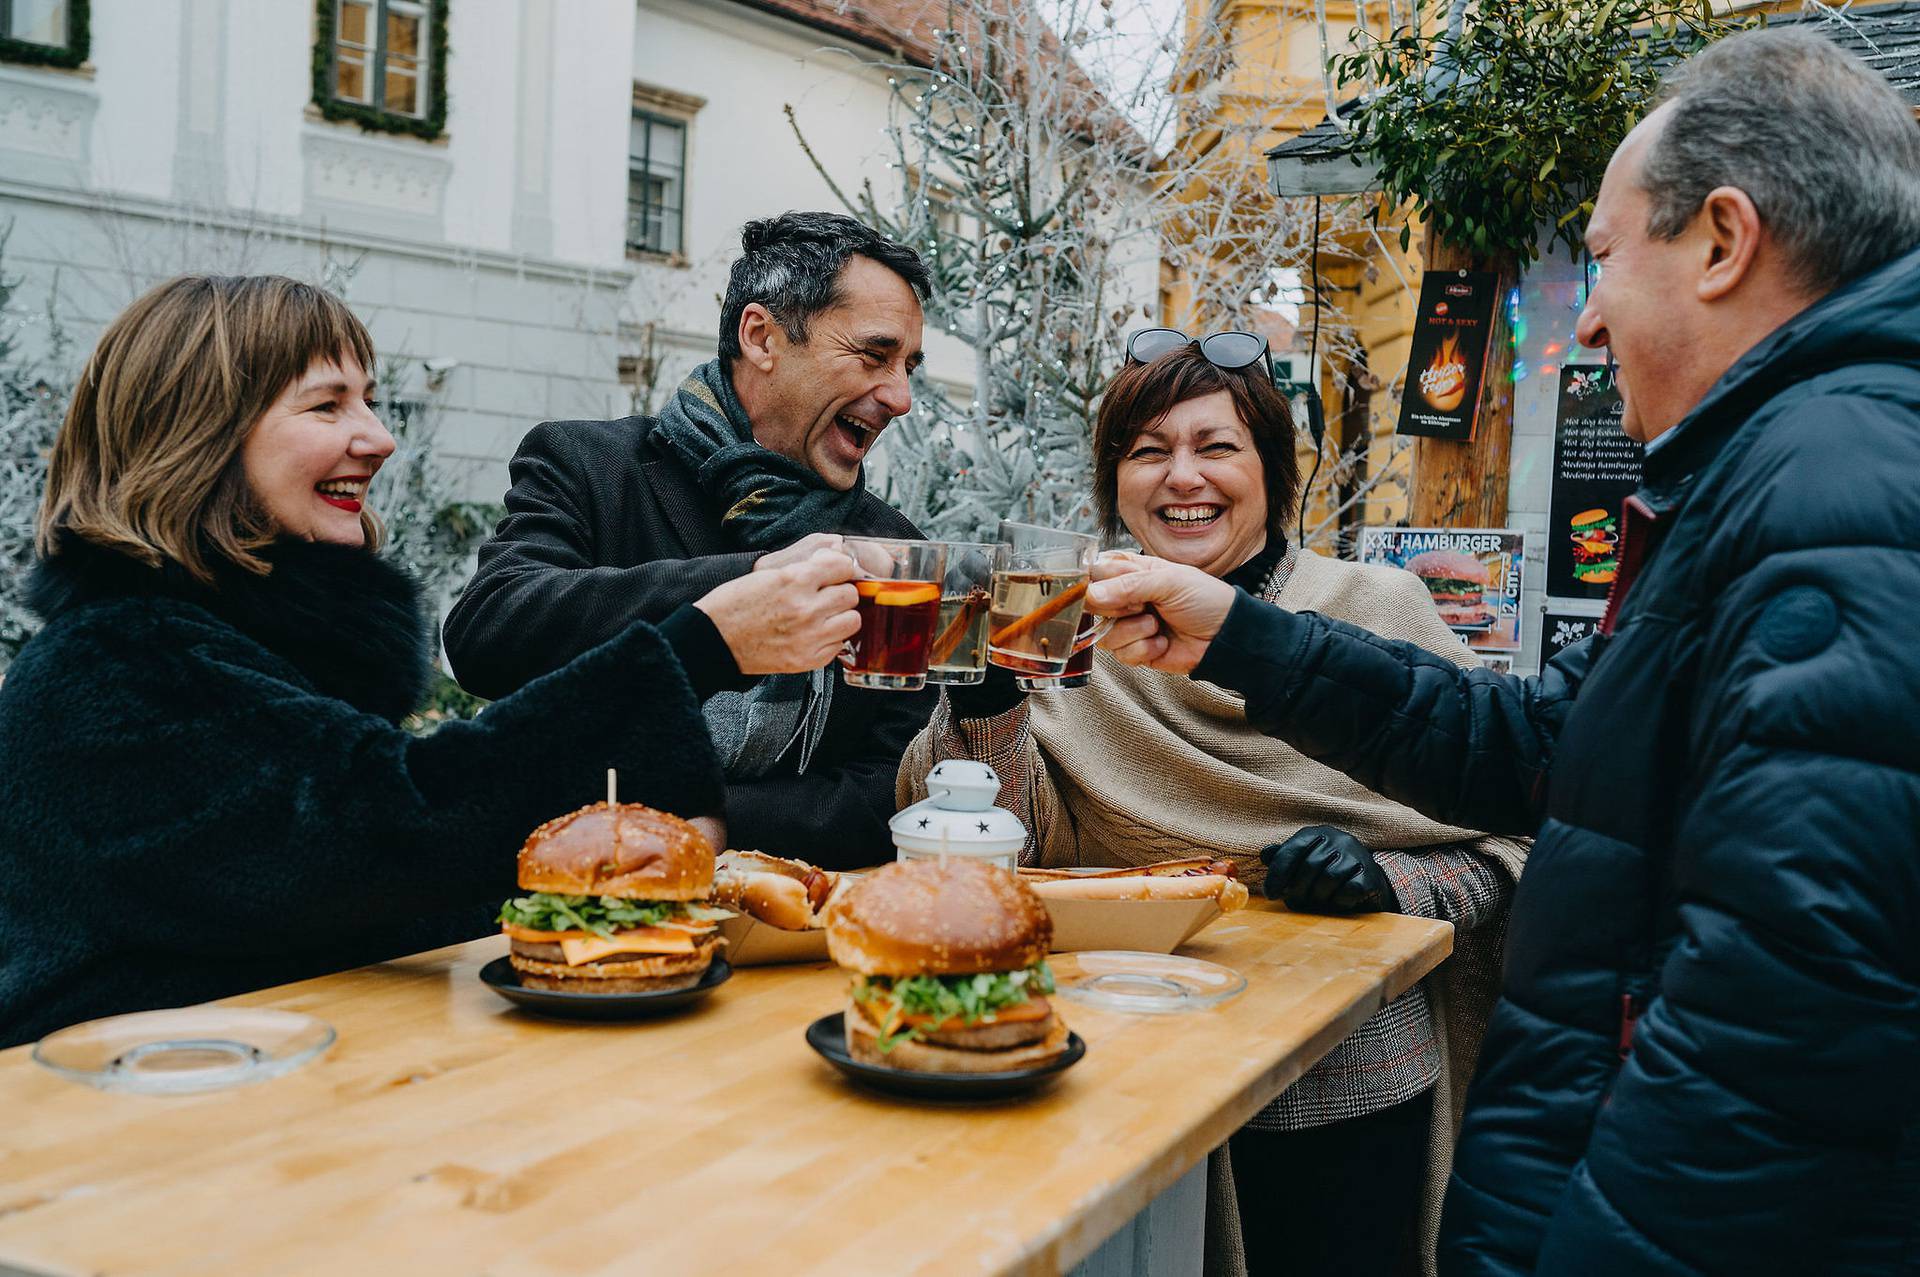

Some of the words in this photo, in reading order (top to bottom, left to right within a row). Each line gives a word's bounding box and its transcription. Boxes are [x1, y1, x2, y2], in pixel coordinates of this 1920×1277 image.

[1367, 534, 1395, 549] XXL
[1400, 534, 1502, 551] HAMBURGER
[1506, 571, 1519, 597] cm
